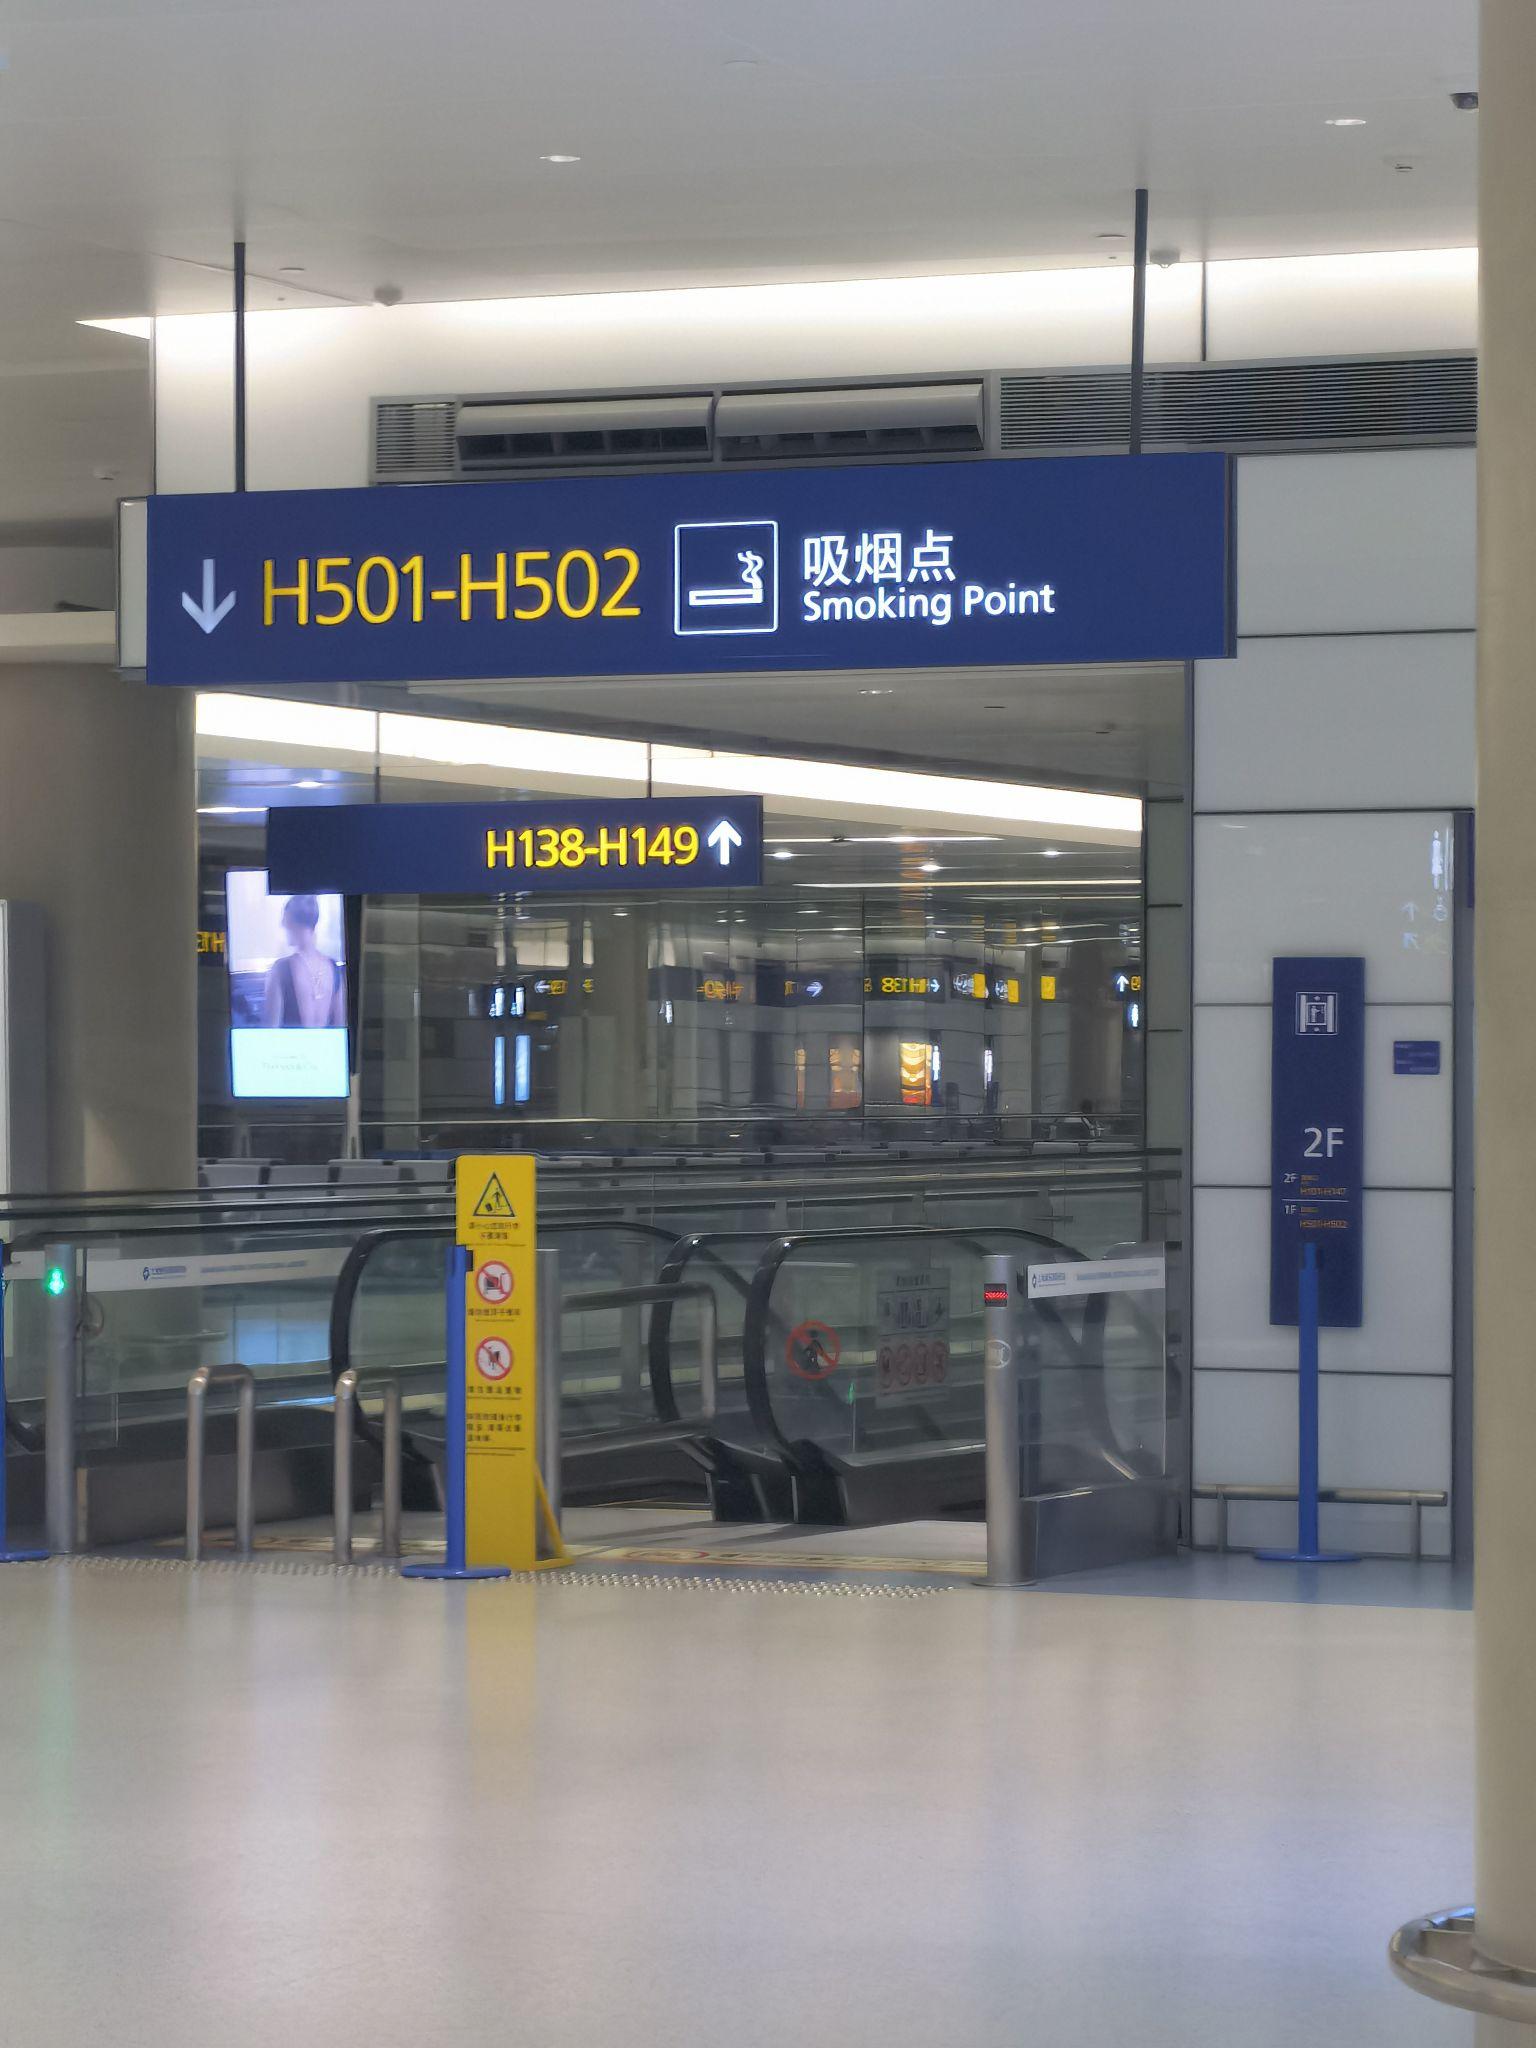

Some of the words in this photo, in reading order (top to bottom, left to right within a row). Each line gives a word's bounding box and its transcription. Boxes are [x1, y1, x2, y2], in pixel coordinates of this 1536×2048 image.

[803, 529, 957, 587] 吸烟点
[263, 547, 641, 626] H501-H502
[803, 588, 953, 626] Smoking
[965, 583, 1056, 617] Point
[486, 825, 699, 869] H138-H149
[1303, 1127, 1344, 1158] 2F
[1284, 1204, 1297, 1215] 1F
